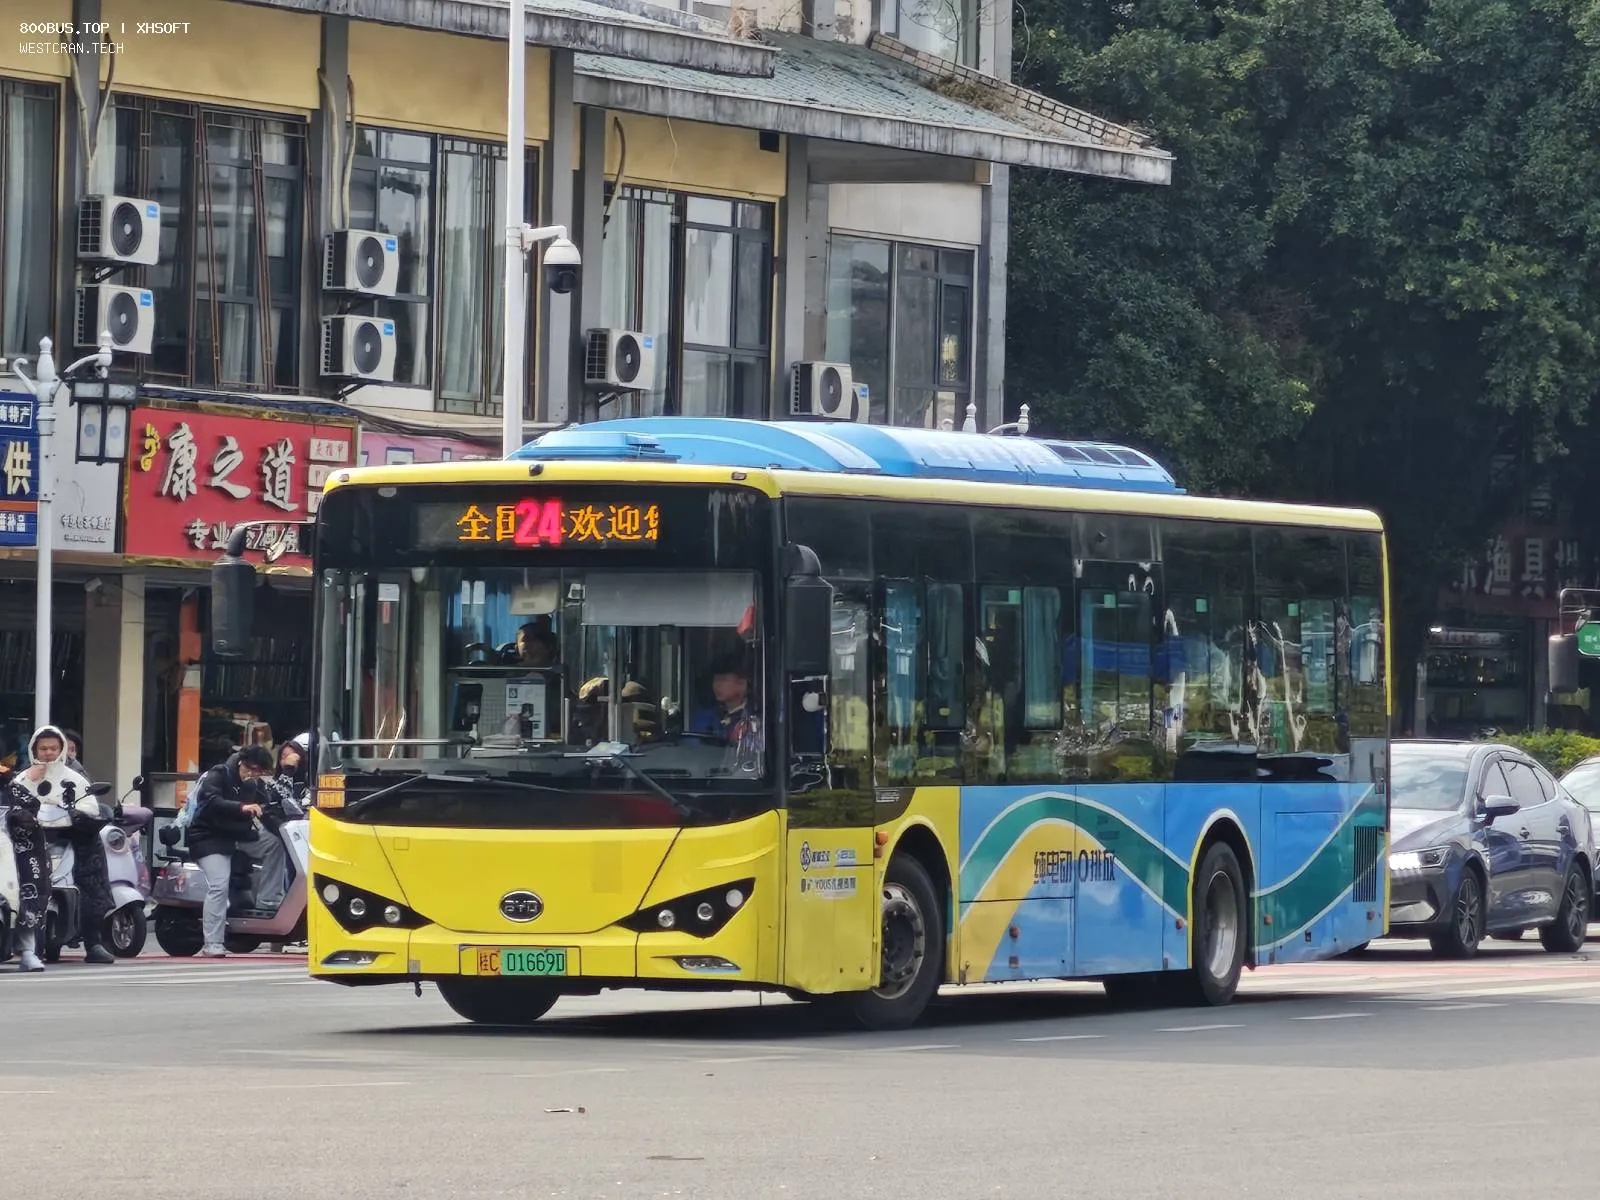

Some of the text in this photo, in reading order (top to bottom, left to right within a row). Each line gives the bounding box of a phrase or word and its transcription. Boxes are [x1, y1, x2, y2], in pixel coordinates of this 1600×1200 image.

[3, 440, 32, 496] 供
[162, 422, 298, 512] 康之道
[457, 505, 659, 541] 全国欢迎
[514, 498, 563, 545] 24
